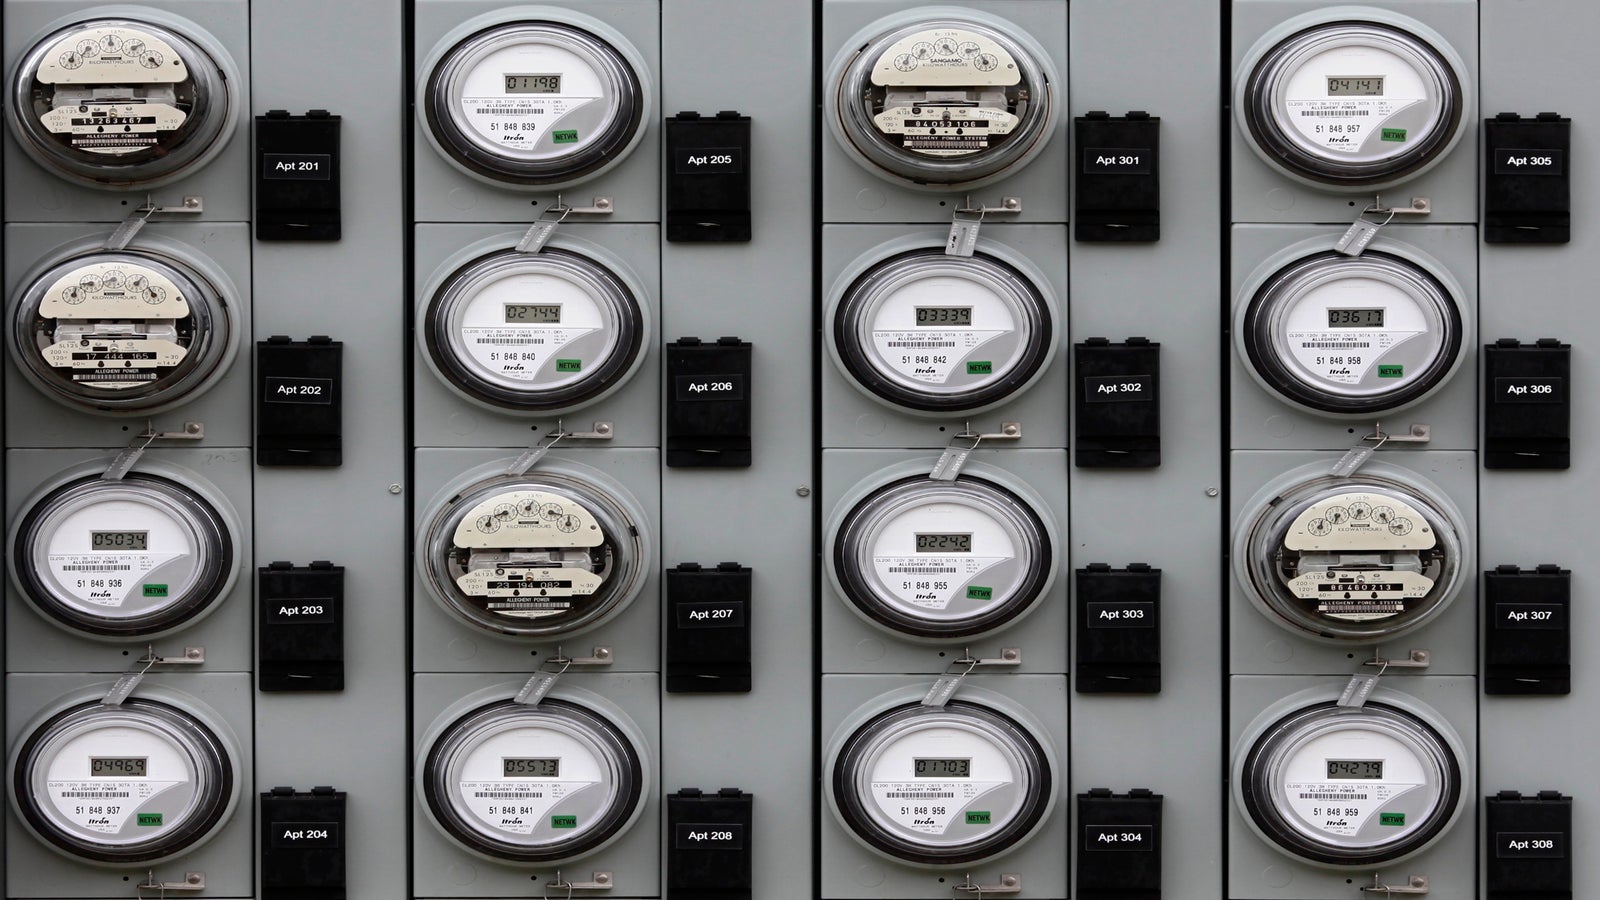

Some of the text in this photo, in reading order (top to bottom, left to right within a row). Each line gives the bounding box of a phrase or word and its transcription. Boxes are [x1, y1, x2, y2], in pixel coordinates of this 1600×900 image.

[507, 77, 558, 89] 01198
[1329, 79, 1381, 92] 04141
[1316, 125, 1360, 133] 51 848 957
[688, 156, 707, 165] Apt
[1096, 156, 1138, 165] Apt 301
[1507, 157, 1551, 166] Apt 305
[276, 162, 318, 171] Apt 201
[507, 307, 558, 319] 02744
[918, 309, 969, 322] 03339
[1330, 311, 1381, 323] 03617
[902, 356, 947, 364] 51 848 842
[278, 385, 321, 395] Apt 202
[689, 382, 732, 393] Apt 206
[1098, 383, 1141, 394] Apt 302
[1508, 385, 1552, 395] Apt 306
[94, 533, 145, 546] 05034
[918, 535, 969, 548] 02242
[77, 580, 122, 588] 51 848 936
[279, 606, 323, 616] Apt 203
[690, 610, 733, 620] Apt 207
[1100, 610, 1143, 620] Apt 303
[1508, 611, 1552, 621] Apt 307
[93, 760, 144, 772] 04969
[506, 760, 557, 772] 05573
[917, 760, 967, 772] 01703
[1329, 762, 1380, 774] 04279
[76, 806, 120, 814] 51 848 937
[901, 807, 946, 815] 51 848 956
[1313, 808, 1358, 816] 51 848 959
[284, 830, 327, 840] Apt 204
[688, 832, 732, 841] Apt 208
[1098, 833, 1142, 843] Apt 304
[1509, 840, 1553, 850] Apt 308
